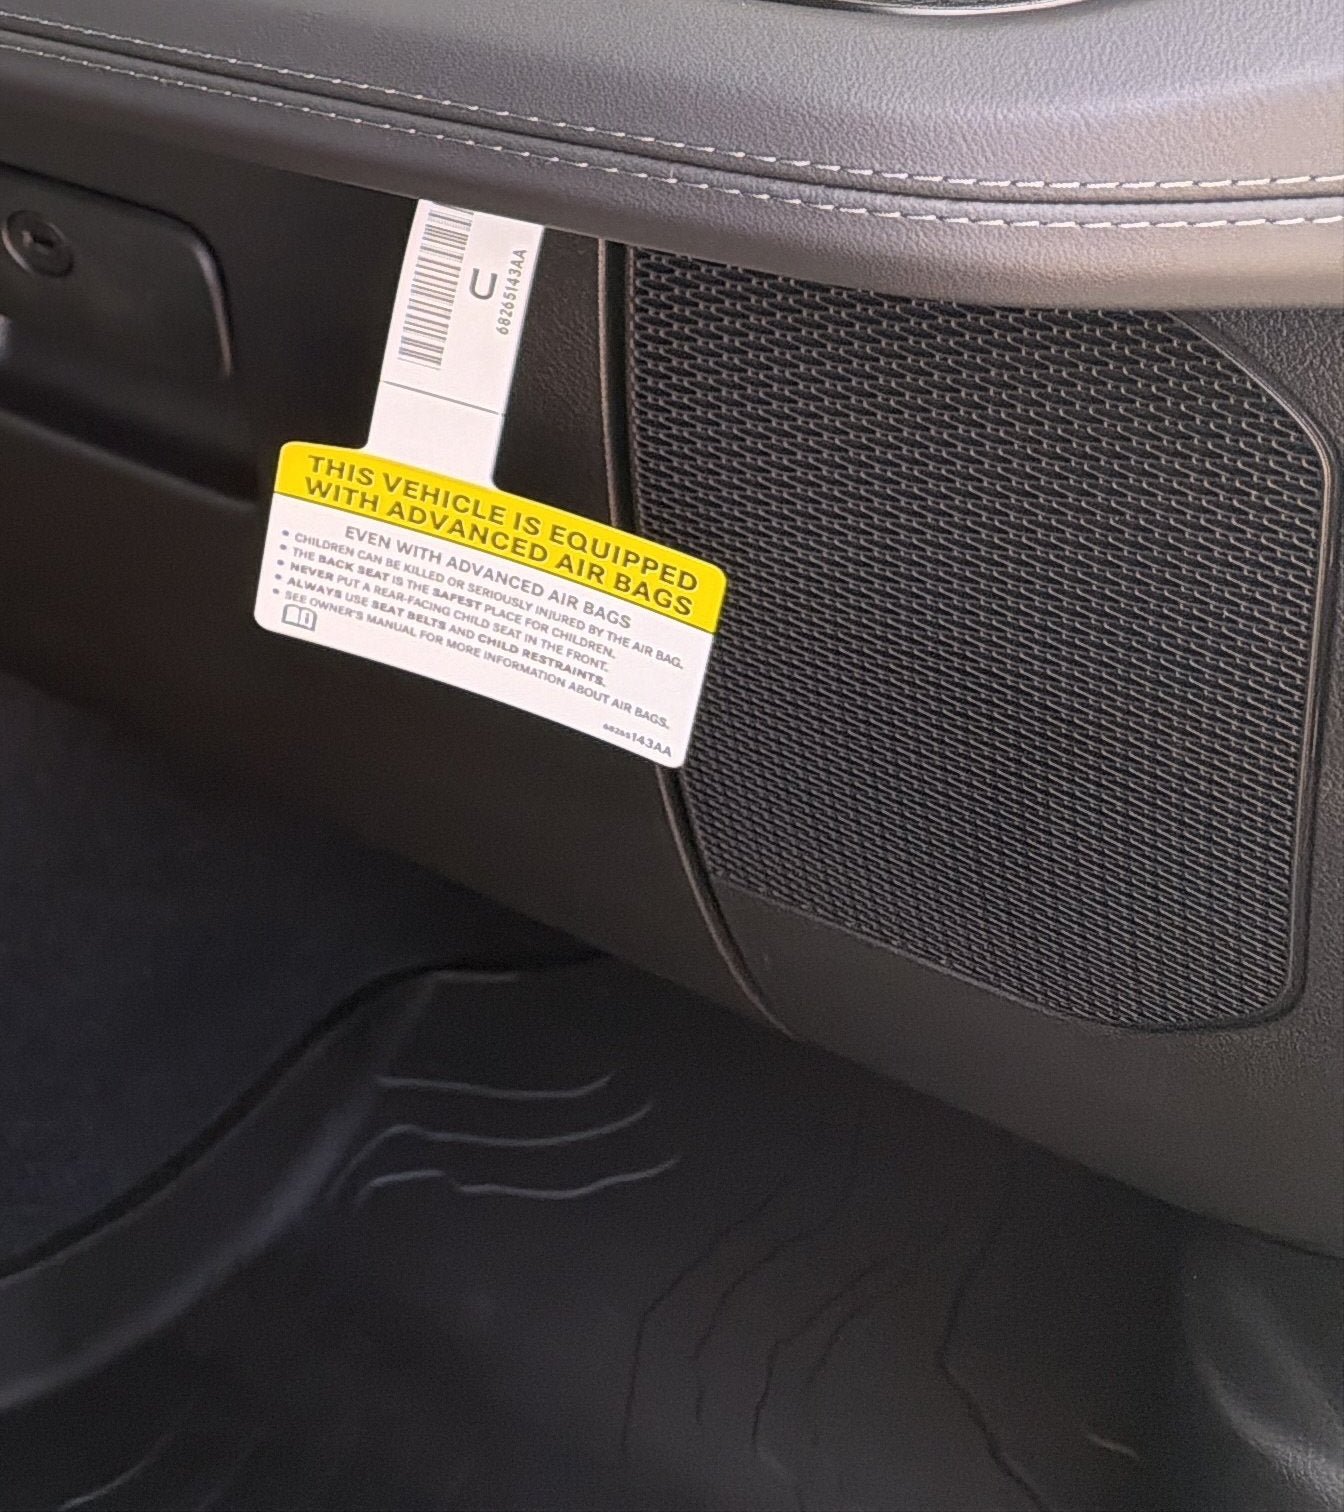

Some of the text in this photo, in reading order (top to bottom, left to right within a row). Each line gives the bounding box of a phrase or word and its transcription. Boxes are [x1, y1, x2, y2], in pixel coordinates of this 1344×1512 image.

[469, 268, 498, 300] U
[496, 249, 528, 335] 68265143AA
[305, 477, 692, 615] WITH ADVANCED AIR BAGS
[308, 455, 697, 590] THIS VEHICLE IS EQUIPPED
[345, 526, 631, 628] EVEN WITH ADVANCED AIR BAGS
[287, 577, 605, 687] ALWAYS USE SEAT BELTS AND CHILD RESTRAINTS.
[290, 562, 608, 672] NEVER PUT A REAR-FACING CHILD SEAT IN THE FRONT.
[293, 547, 615, 659] THE BACK SEAT IS THE SAFEST PLACE FOR CHILDREN.
[295, 533, 354, 556] CHILDREN
[357, 550, 382, 564] CAN
[386, 558, 400, 570] BE
[403, 563, 445, 583] KILLED
[447, 577, 465, 590] OR
[467, 583, 533, 611] SERIOUSLY
[535, 606, 585, 630] INJURED
[588, 624, 604, 637] BY
[608, 631, 630, 648] THE
[632, 642, 653, 657] AIR
[285, 591, 669, 729] SEE OWNER'S MANUAL FOR MORE INFORMATION ABOUT AIR BAGS.
